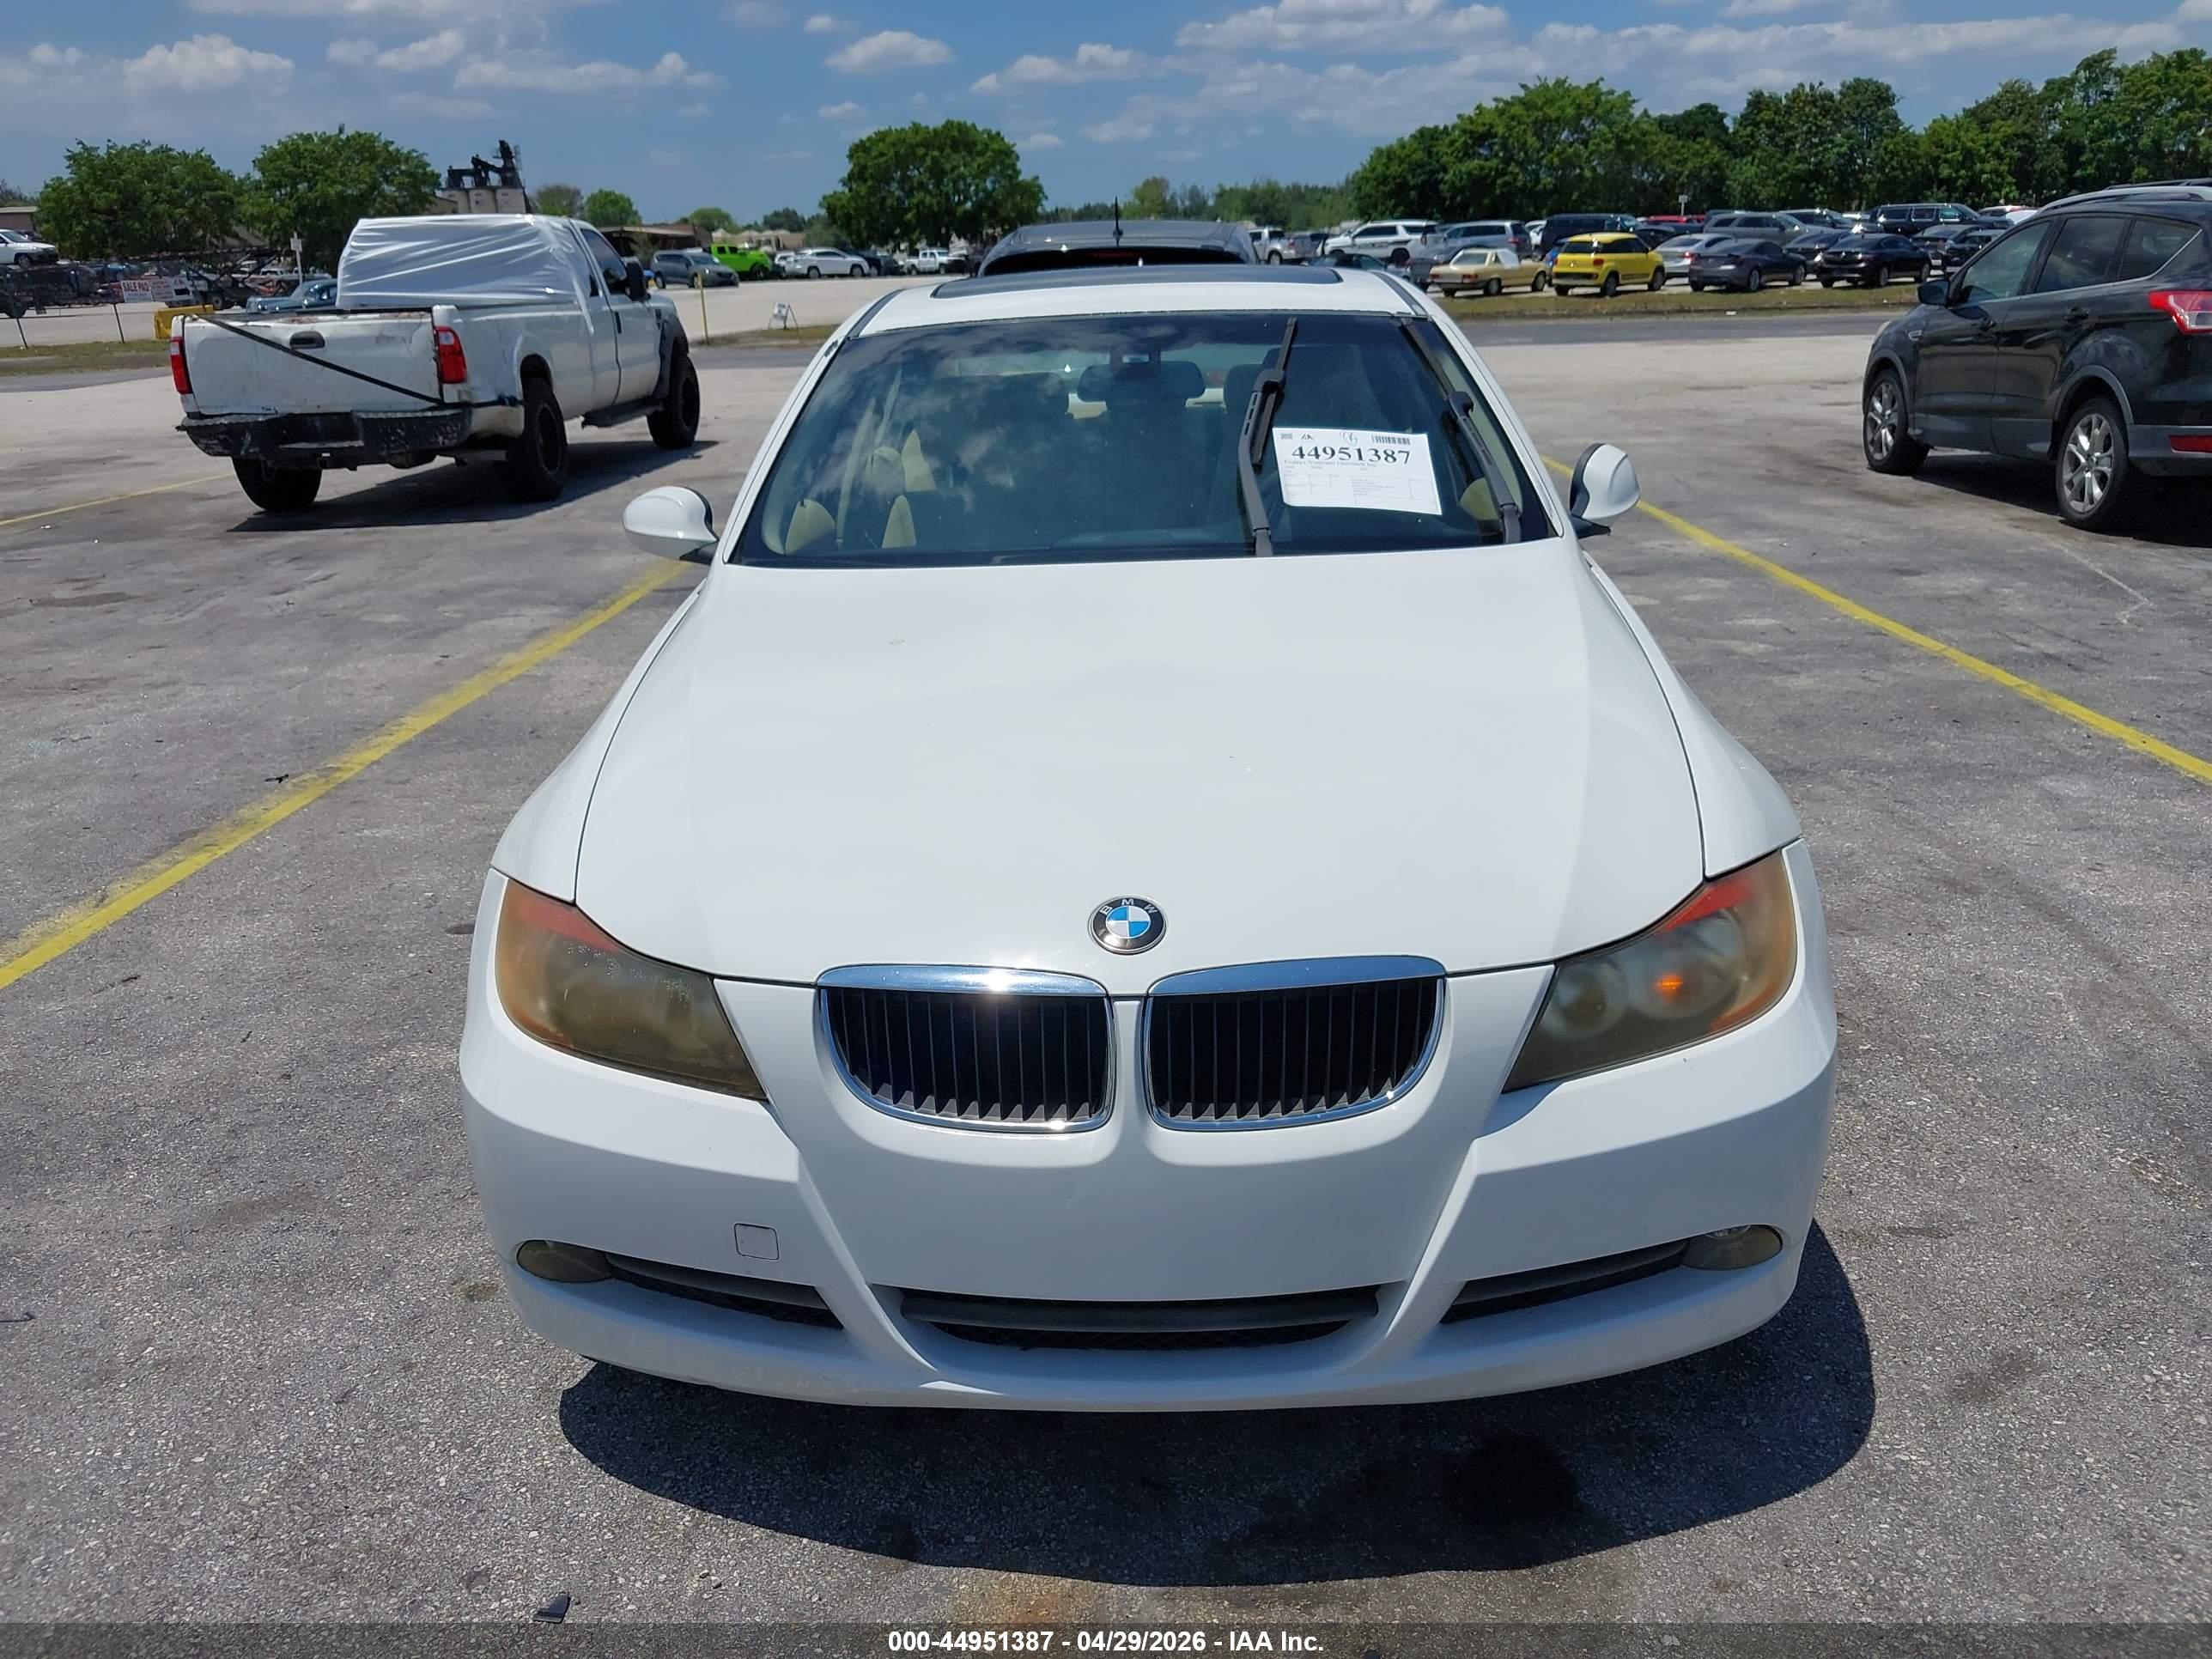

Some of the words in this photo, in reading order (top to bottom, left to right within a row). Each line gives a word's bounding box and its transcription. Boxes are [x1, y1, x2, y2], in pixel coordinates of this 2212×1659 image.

[123, 281, 137, 292] SALE
[1291, 445, 1410, 465] 44951387
[1099, 898, 1158, 915] BMW
